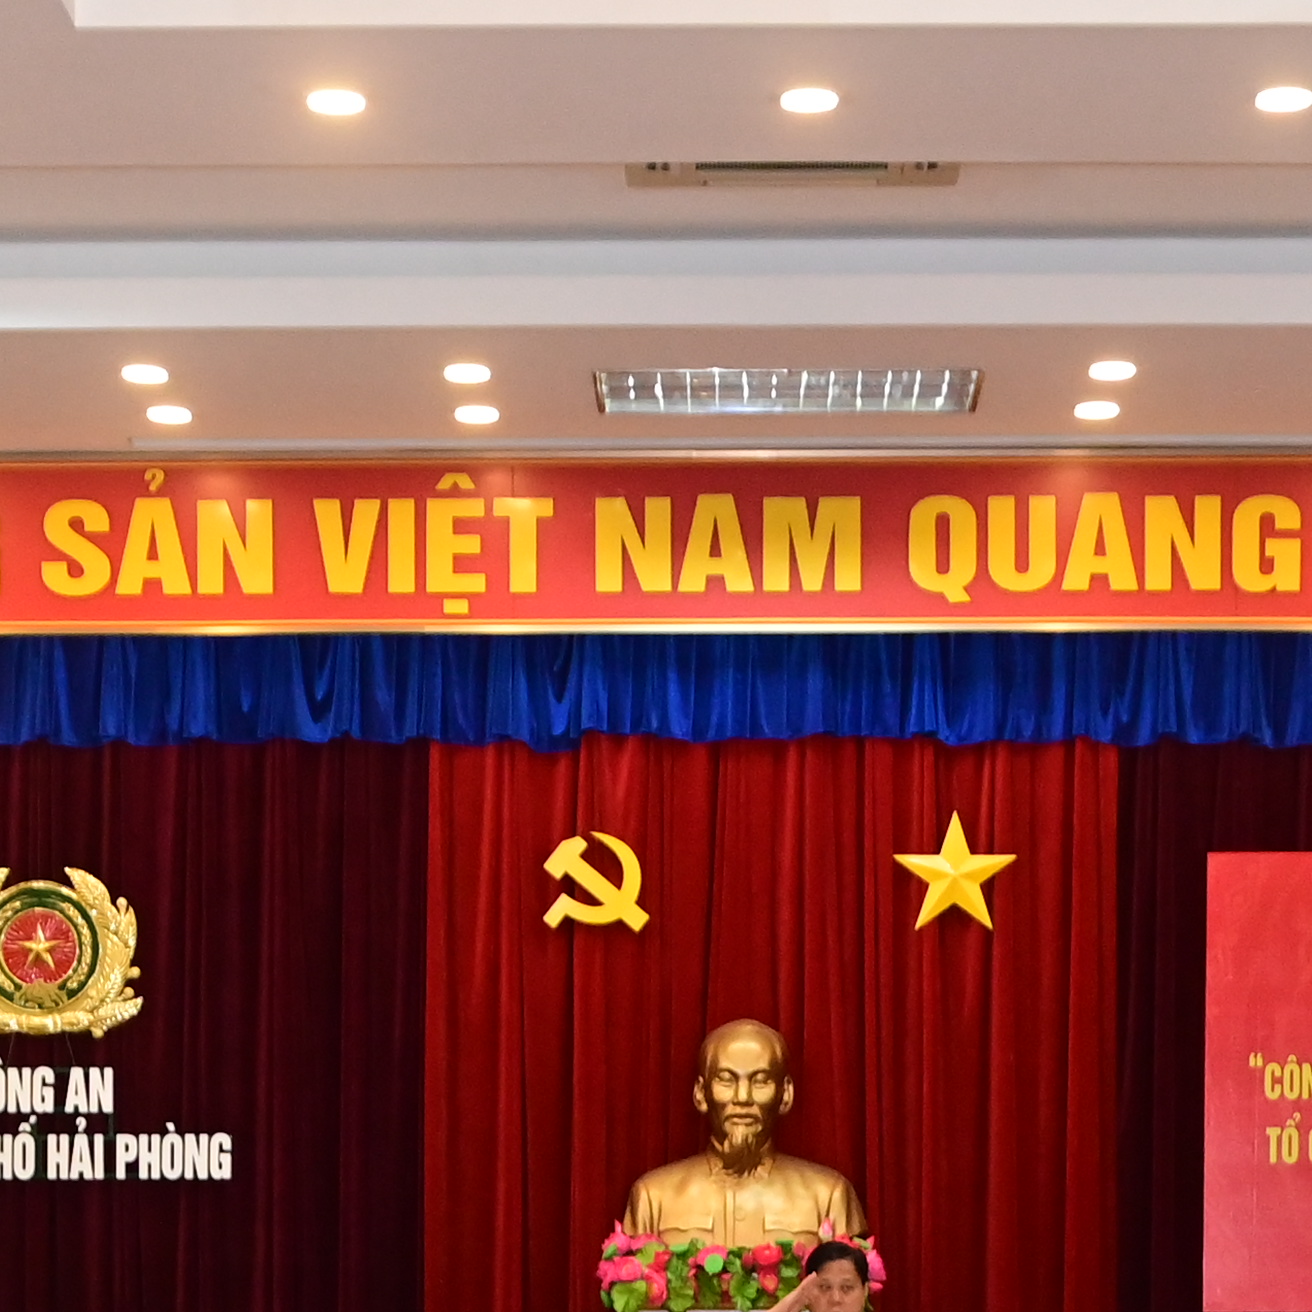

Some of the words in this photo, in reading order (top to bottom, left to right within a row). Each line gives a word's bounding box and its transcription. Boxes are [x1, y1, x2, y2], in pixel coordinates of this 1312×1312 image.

[42, 469, 273, 596] SẢN
[314, 474, 553, 615] VIỆT
[595, 494, 862, 595] NAM
[909, 472, 1301, 603] QUANG
[65, 1067, 113, 1113] AN
[47, 1117, 104, 1180] HẢI
[116, 1122, 231, 1180] PHÒNG
[1266, 1112, 1300, 1164] TỔ
